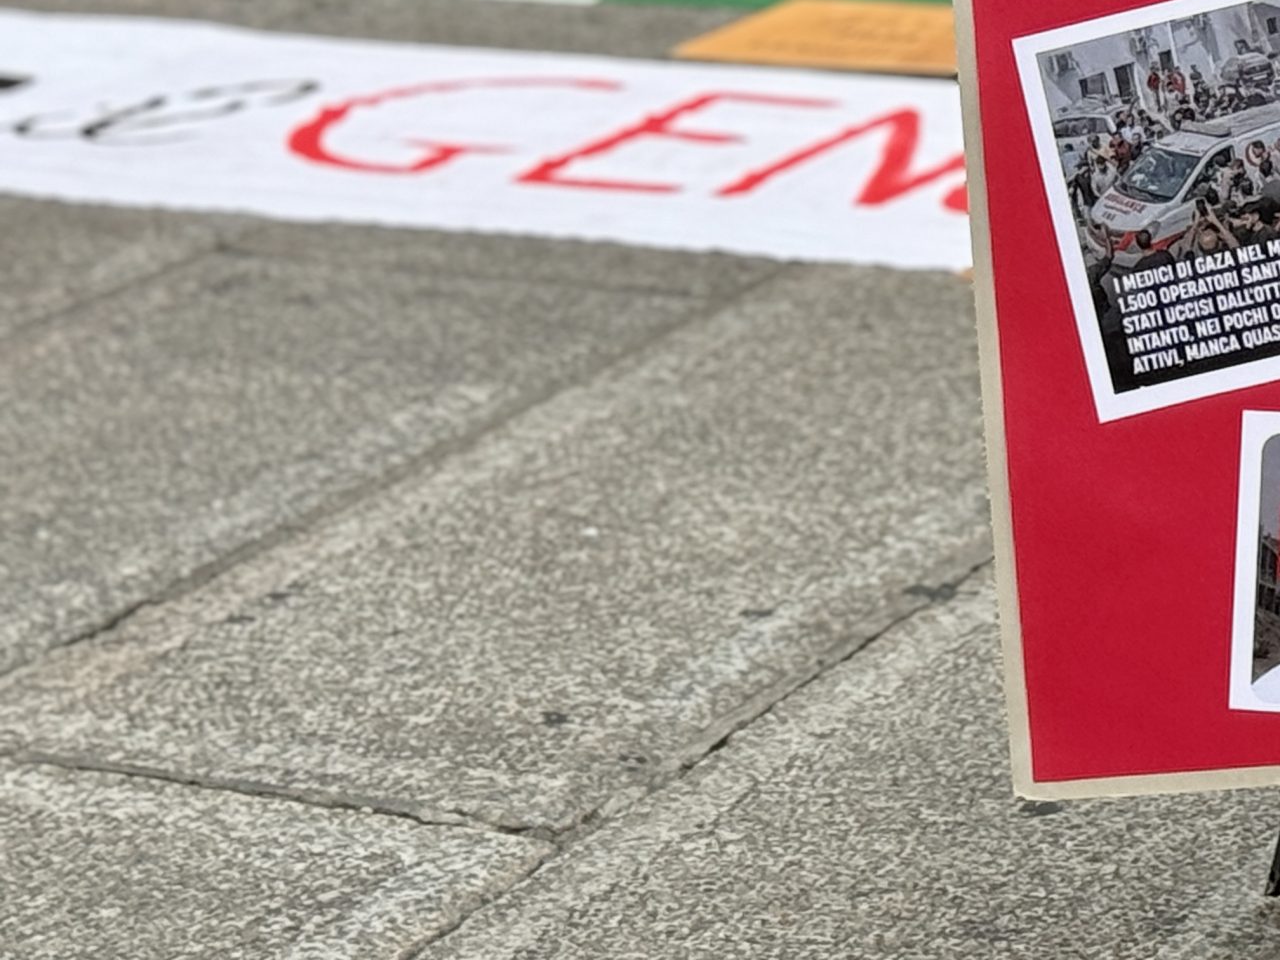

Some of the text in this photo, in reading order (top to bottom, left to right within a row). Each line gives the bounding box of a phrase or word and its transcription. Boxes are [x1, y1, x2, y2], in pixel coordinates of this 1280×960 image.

[286, 76, 970, 216] GEN
[1113, 277, 1120, 294] I
[1122, 264, 1174, 291] MEDICI
[1176, 260, 1193, 279] DI
[1195, 250, 1235, 274] GAZA
[1236, 243, 1266, 265] NEL
[1117, 290, 1157, 314] 1.500
[1159, 270, 1240, 304] OPERATORI
[1122, 309, 1163, 334] STATI
[1164, 297, 1216, 324] UCCISI
[1127, 324, 1195, 355] INTANTO,
[1195, 317, 1222, 338] NEI
[1222, 306, 1269, 332] POCHI
[1133, 348, 1184, 376] ATTIVI,
[1184, 335, 1241, 363] MANCA
